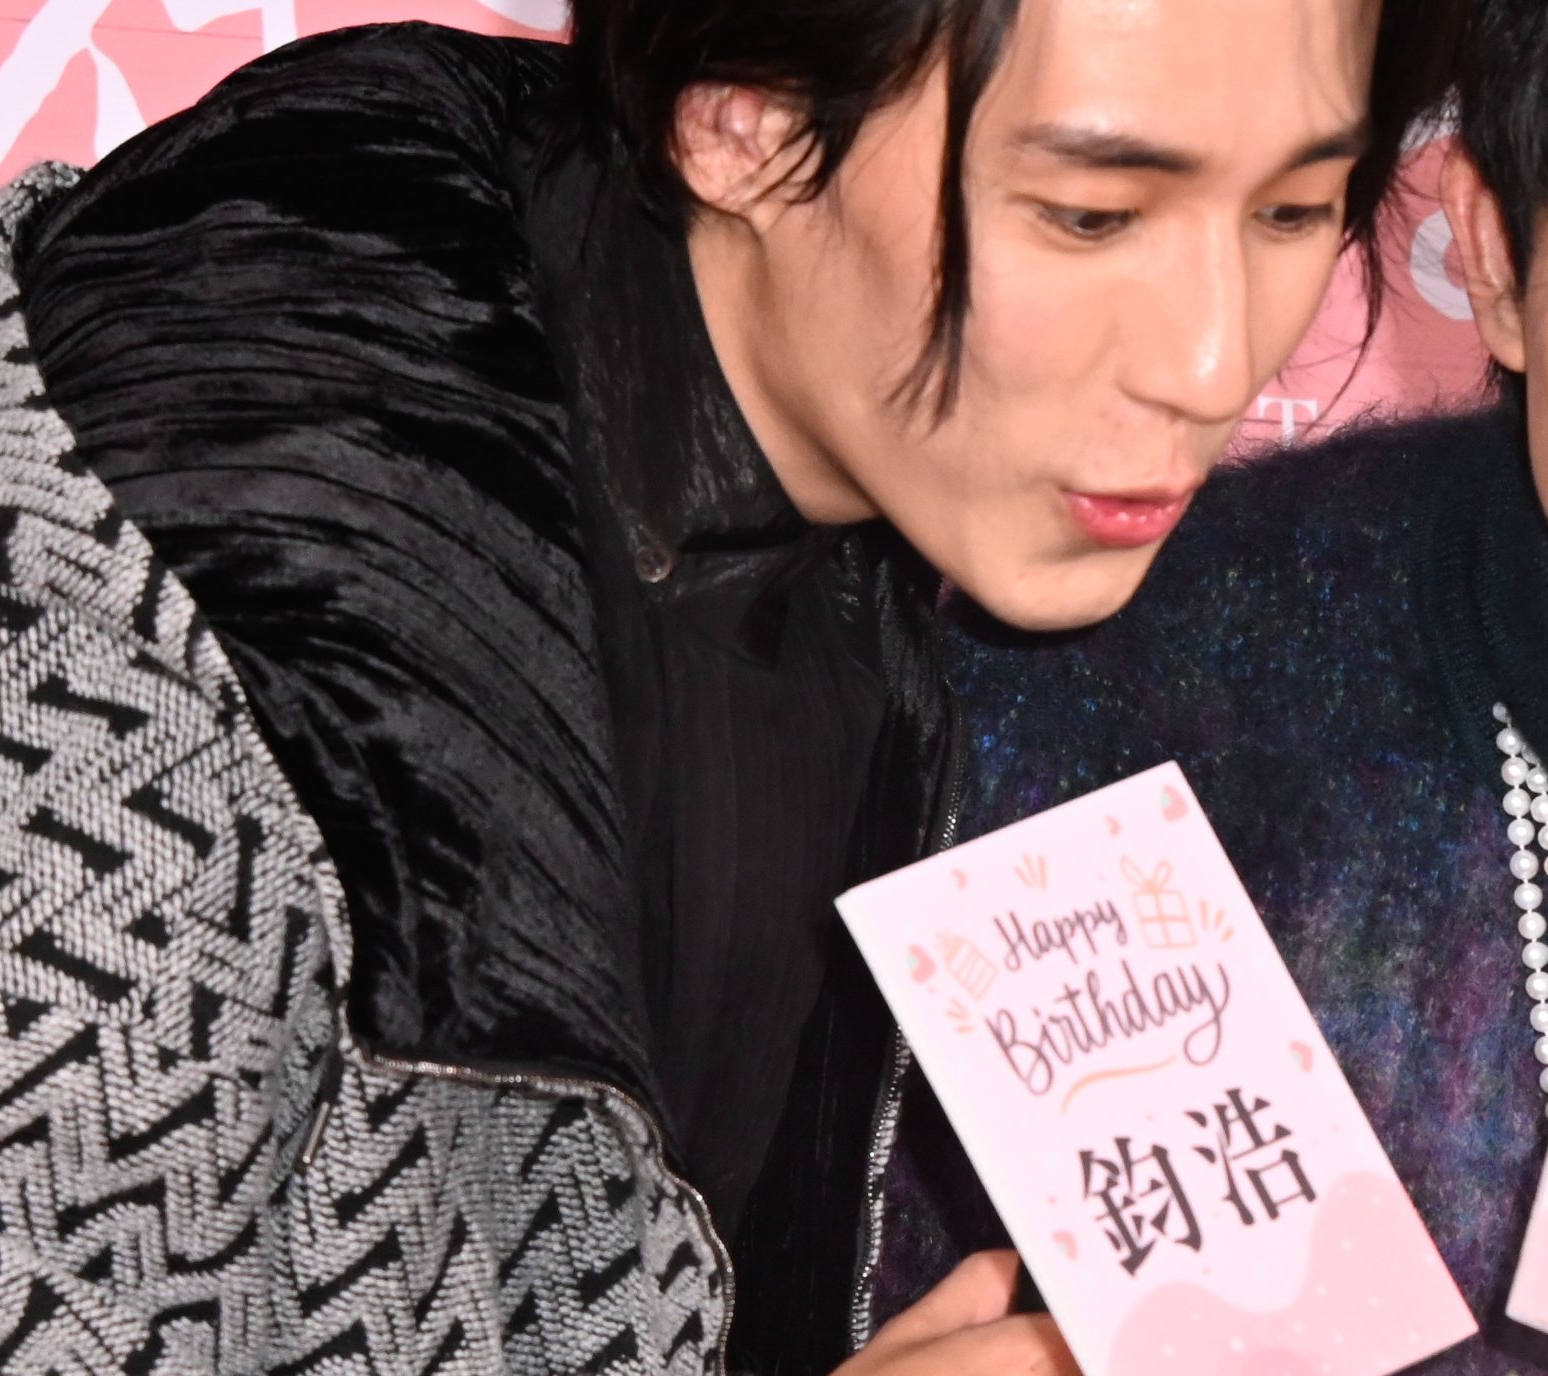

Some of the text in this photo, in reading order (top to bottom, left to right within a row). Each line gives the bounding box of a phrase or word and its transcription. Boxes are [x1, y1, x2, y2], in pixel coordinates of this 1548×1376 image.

[993, 898, 1129, 973] Happy
[984, 957, 1231, 1097] Birthday
[1078, 1086, 1318, 1277] 鈞浩
